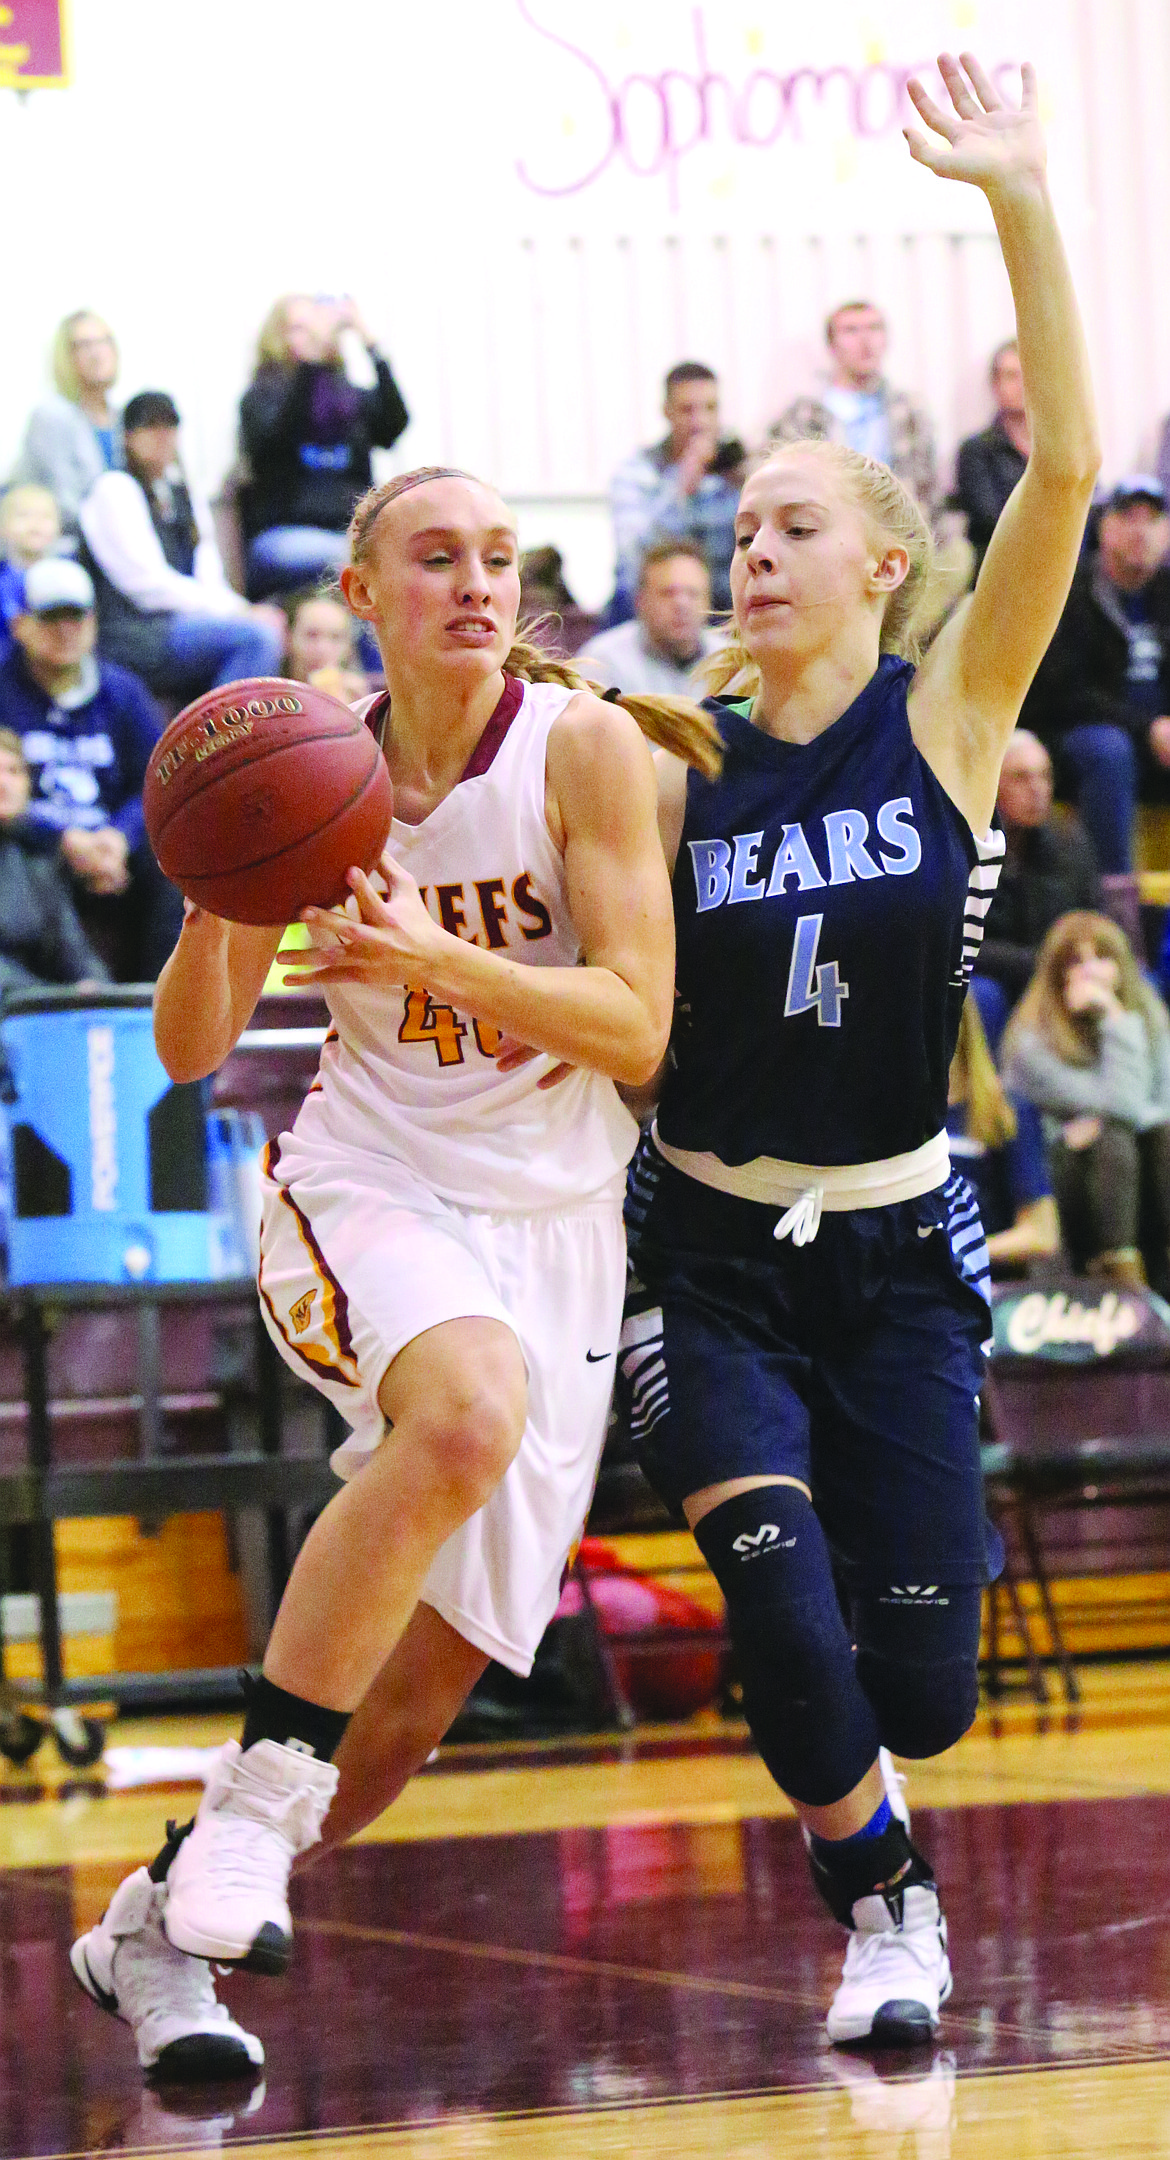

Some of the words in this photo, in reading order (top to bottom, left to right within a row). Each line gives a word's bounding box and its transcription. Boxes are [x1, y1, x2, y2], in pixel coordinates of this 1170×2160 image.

[515, 0, 1028, 214] Sophomor
[687, 797, 922, 913] BEARS
[783, 913, 849, 1028] 4
[1008, 1292, 1138, 1356] Chiefs
